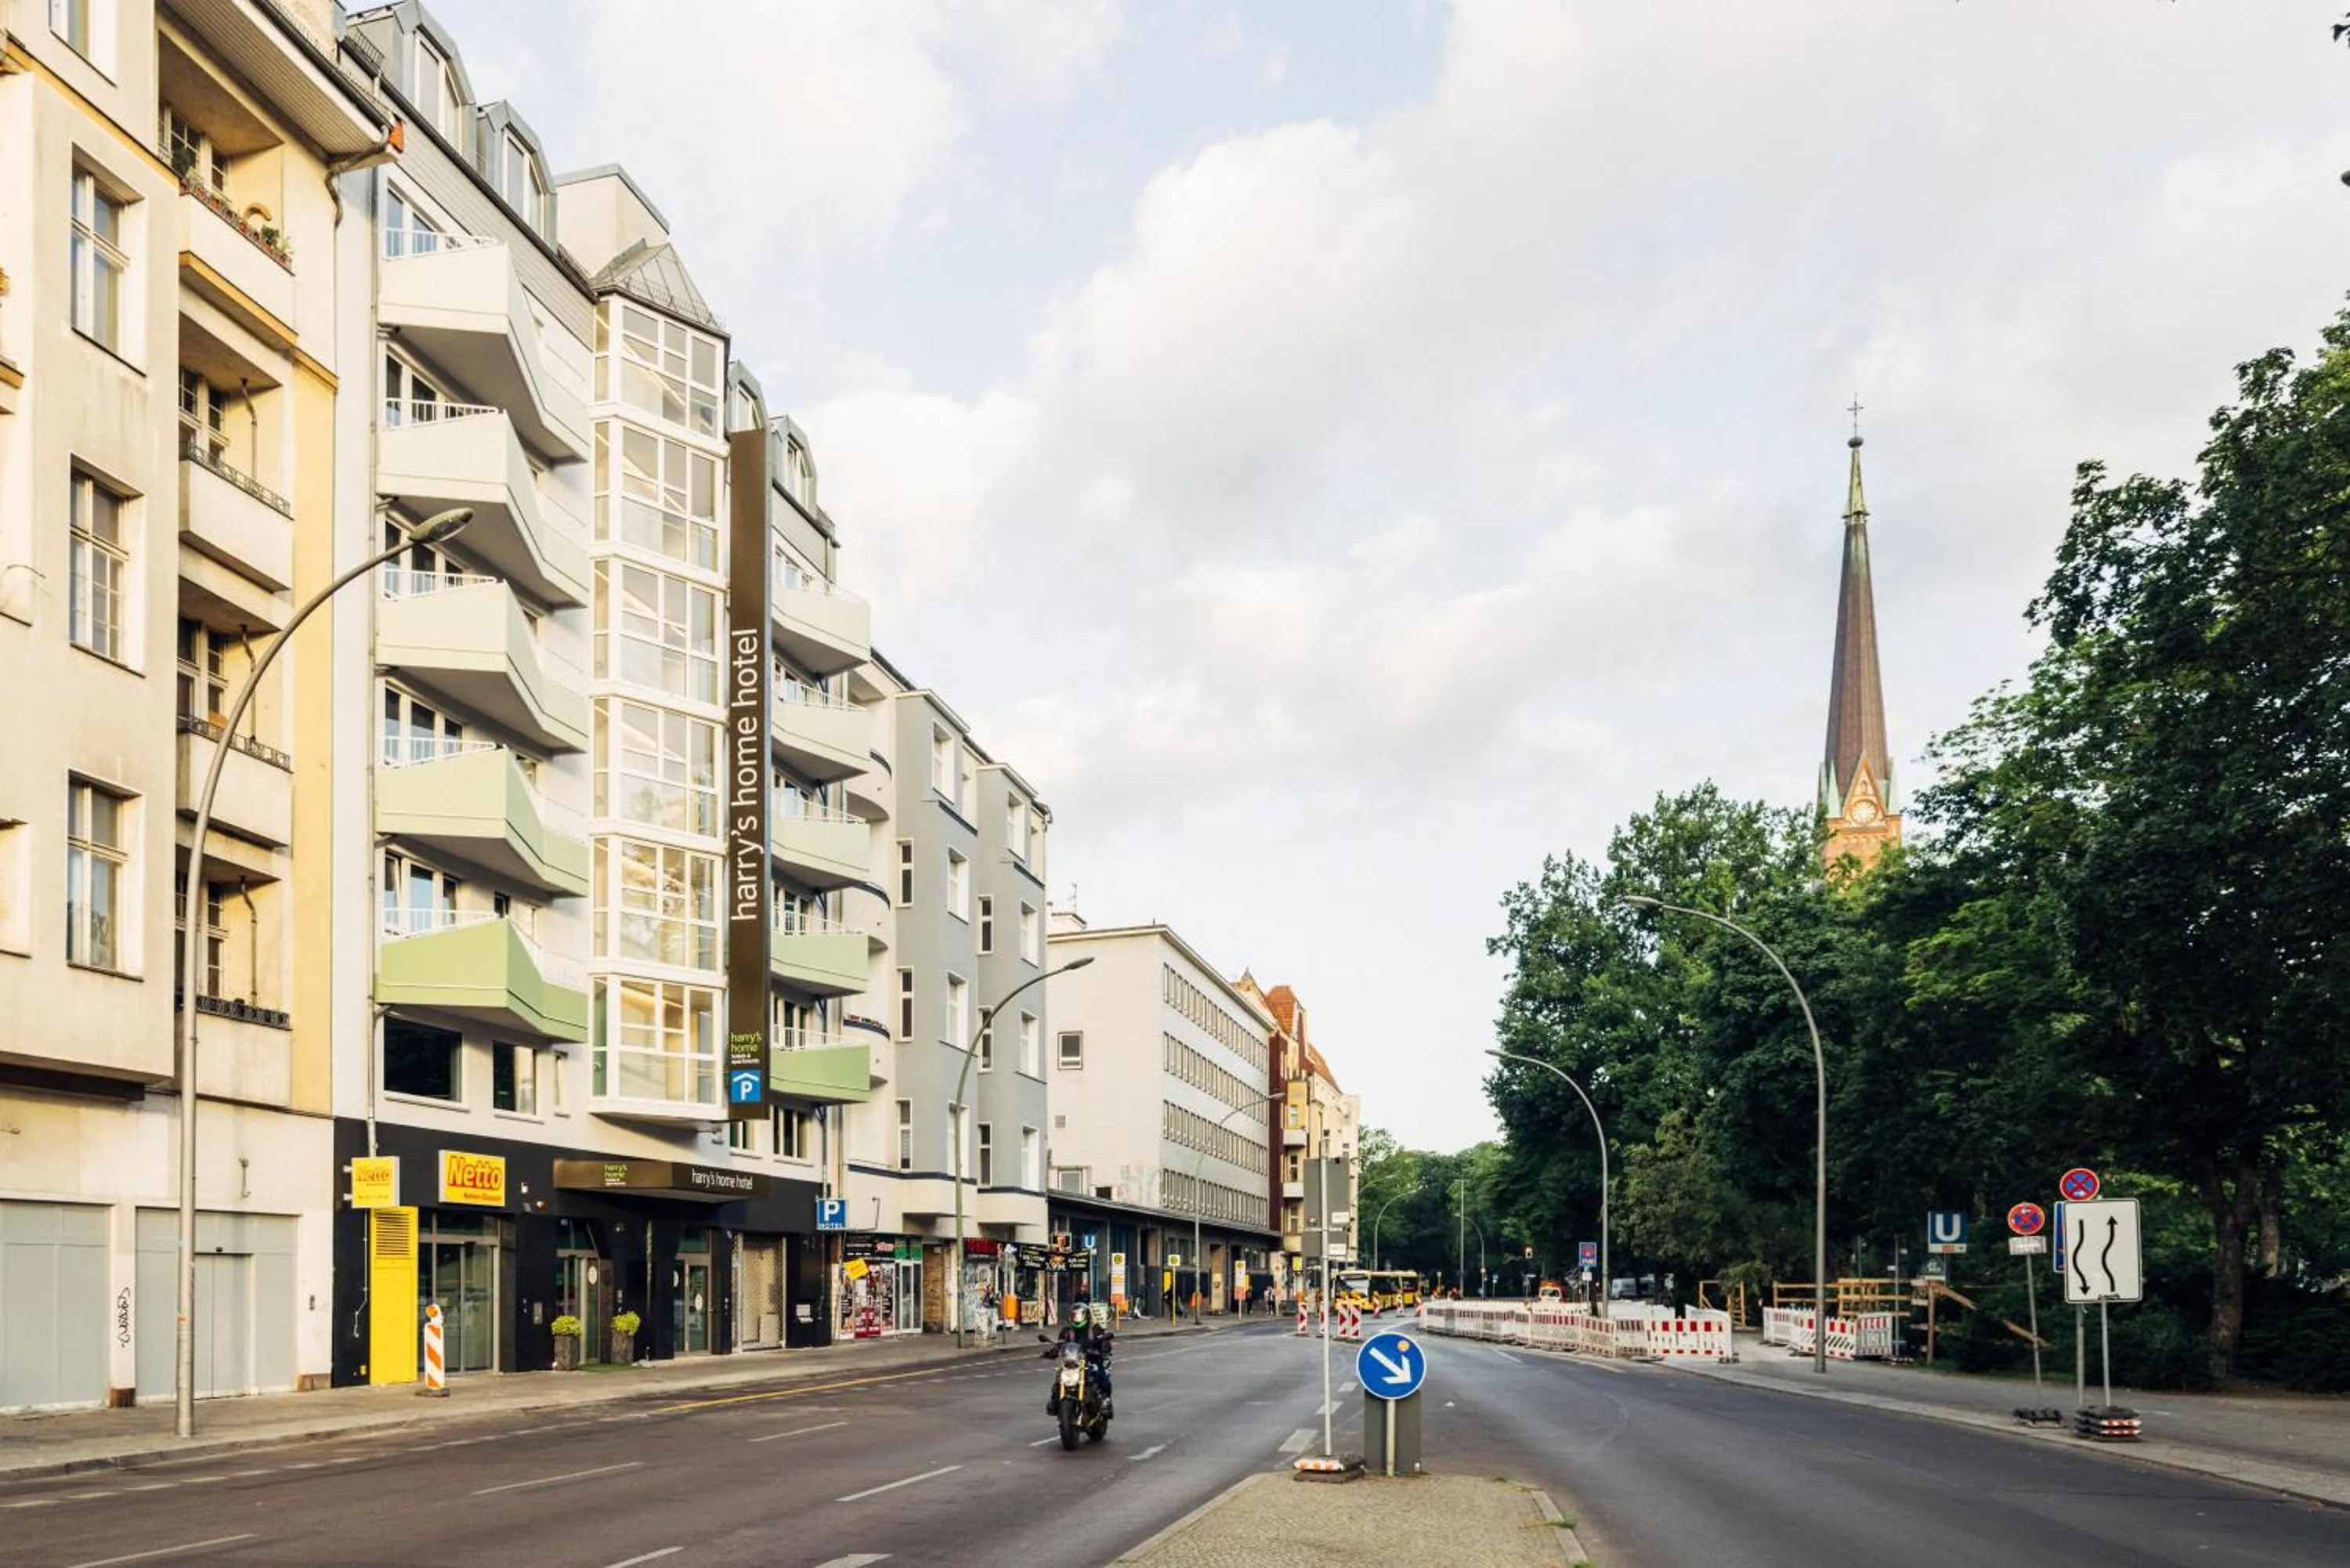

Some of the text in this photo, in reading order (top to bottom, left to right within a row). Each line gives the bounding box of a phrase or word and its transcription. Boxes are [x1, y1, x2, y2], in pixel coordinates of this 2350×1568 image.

[731, 628, 764, 920] harry's home hotel
[731, 1031, 762, 1044] harry's
[731, 1044, 759, 1053] home
[740, 1080, 753, 1100] P
[356, 1167, 390, 1182] Netto
[448, 1155, 502, 1190] Netto
[692, 1168, 753, 1190] harry's home hotel
[823, 1201, 841, 1222] P
[1935, 1213, 1961, 1242] U
[1084, 1234, 1096, 1248] U
